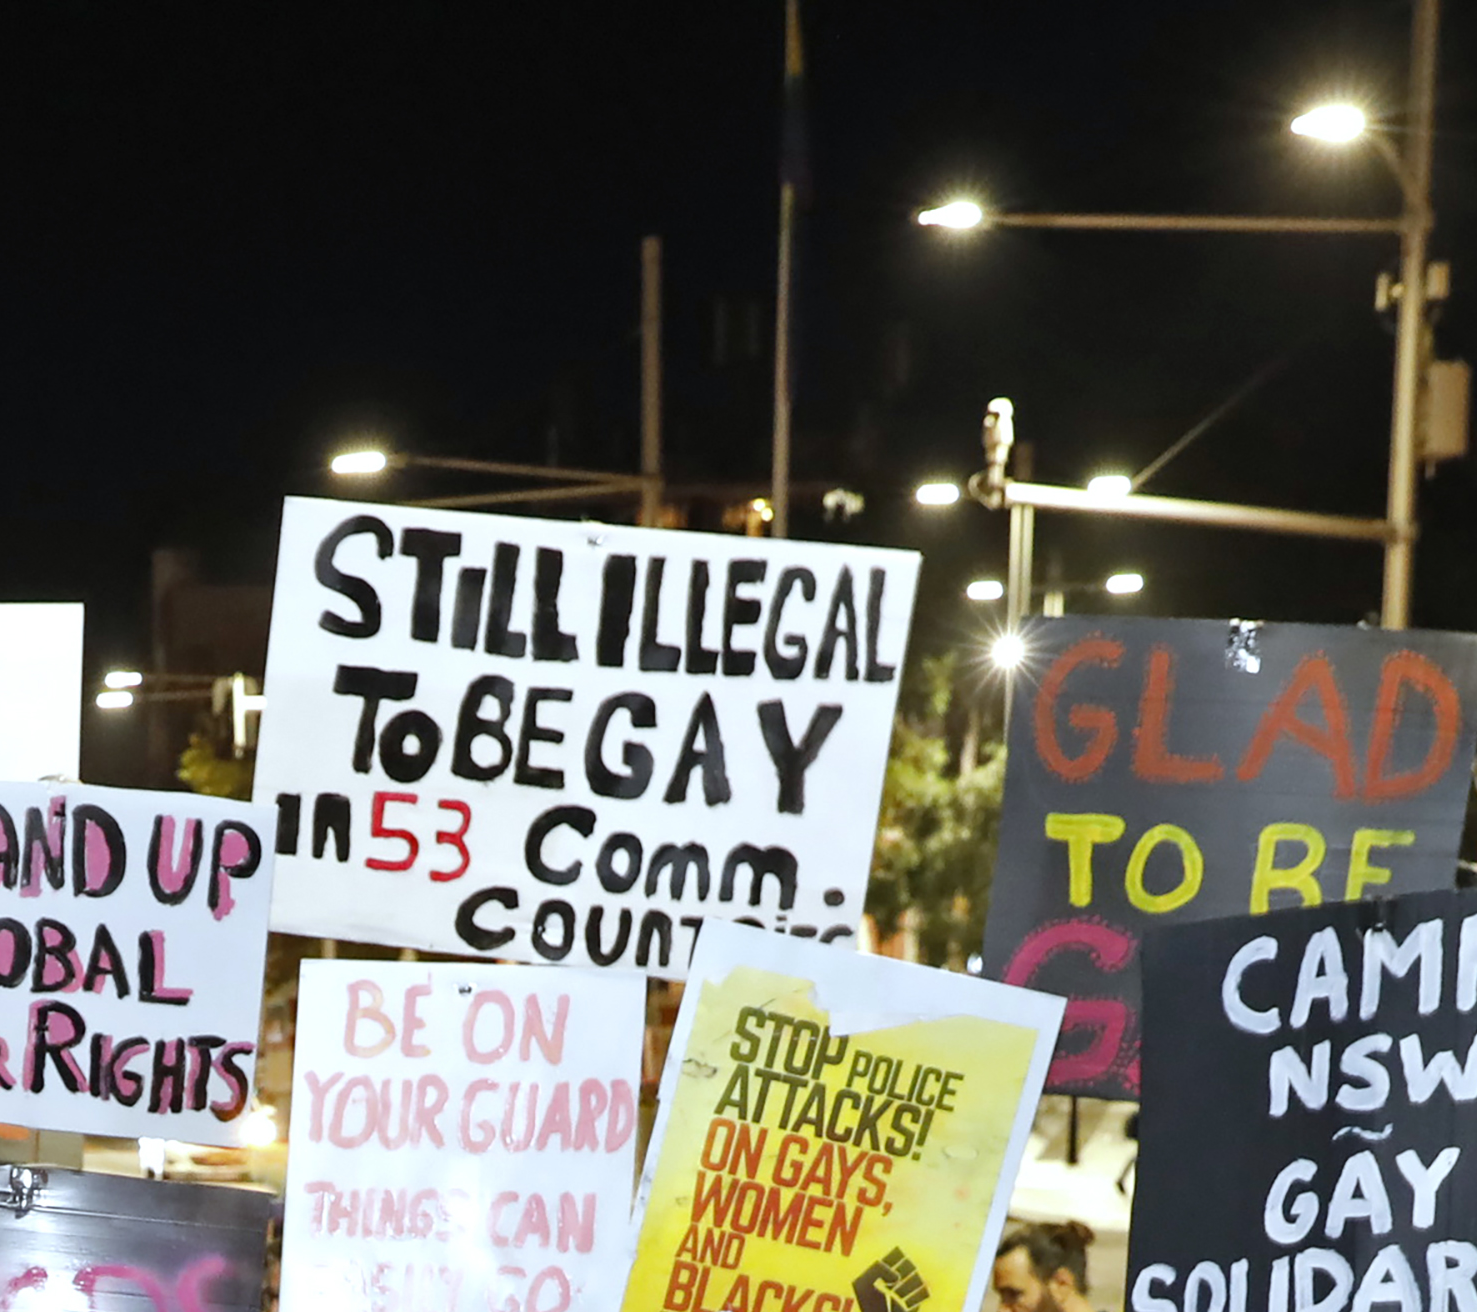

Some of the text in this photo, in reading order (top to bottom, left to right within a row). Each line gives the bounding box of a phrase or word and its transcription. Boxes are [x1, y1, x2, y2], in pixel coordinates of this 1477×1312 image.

[315, 515, 896, 682] STILL ILLEGAL
[451, 675, 573, 788] BE
[584, 690, 843, 815] GAY
[1033, 633, 1462, 802] GLAD
[147, 817, 262, 921] UP
[364, 791, 471, 881] 53
[1045, 813, 1204, 912] TO
[25, 1000, 257, 1123] RIGHTS
[345, 974, 571, 1066] BE ON
[728, 1006, 965, 1115] STOP POLICE
[303, 1071, 636, 1154] YOUR GUARD
[715, 1066, 935, 1160] ATTACKS!
[690, 1171, 866, 1258] WOMEN
[700, 1118, 894, 1217] ON GAYS,
[1264, 1147, 1461, 1244] GAY
[488, 1191, 596, 1254] CAN
[675, 1231, 746, 1272] AND
